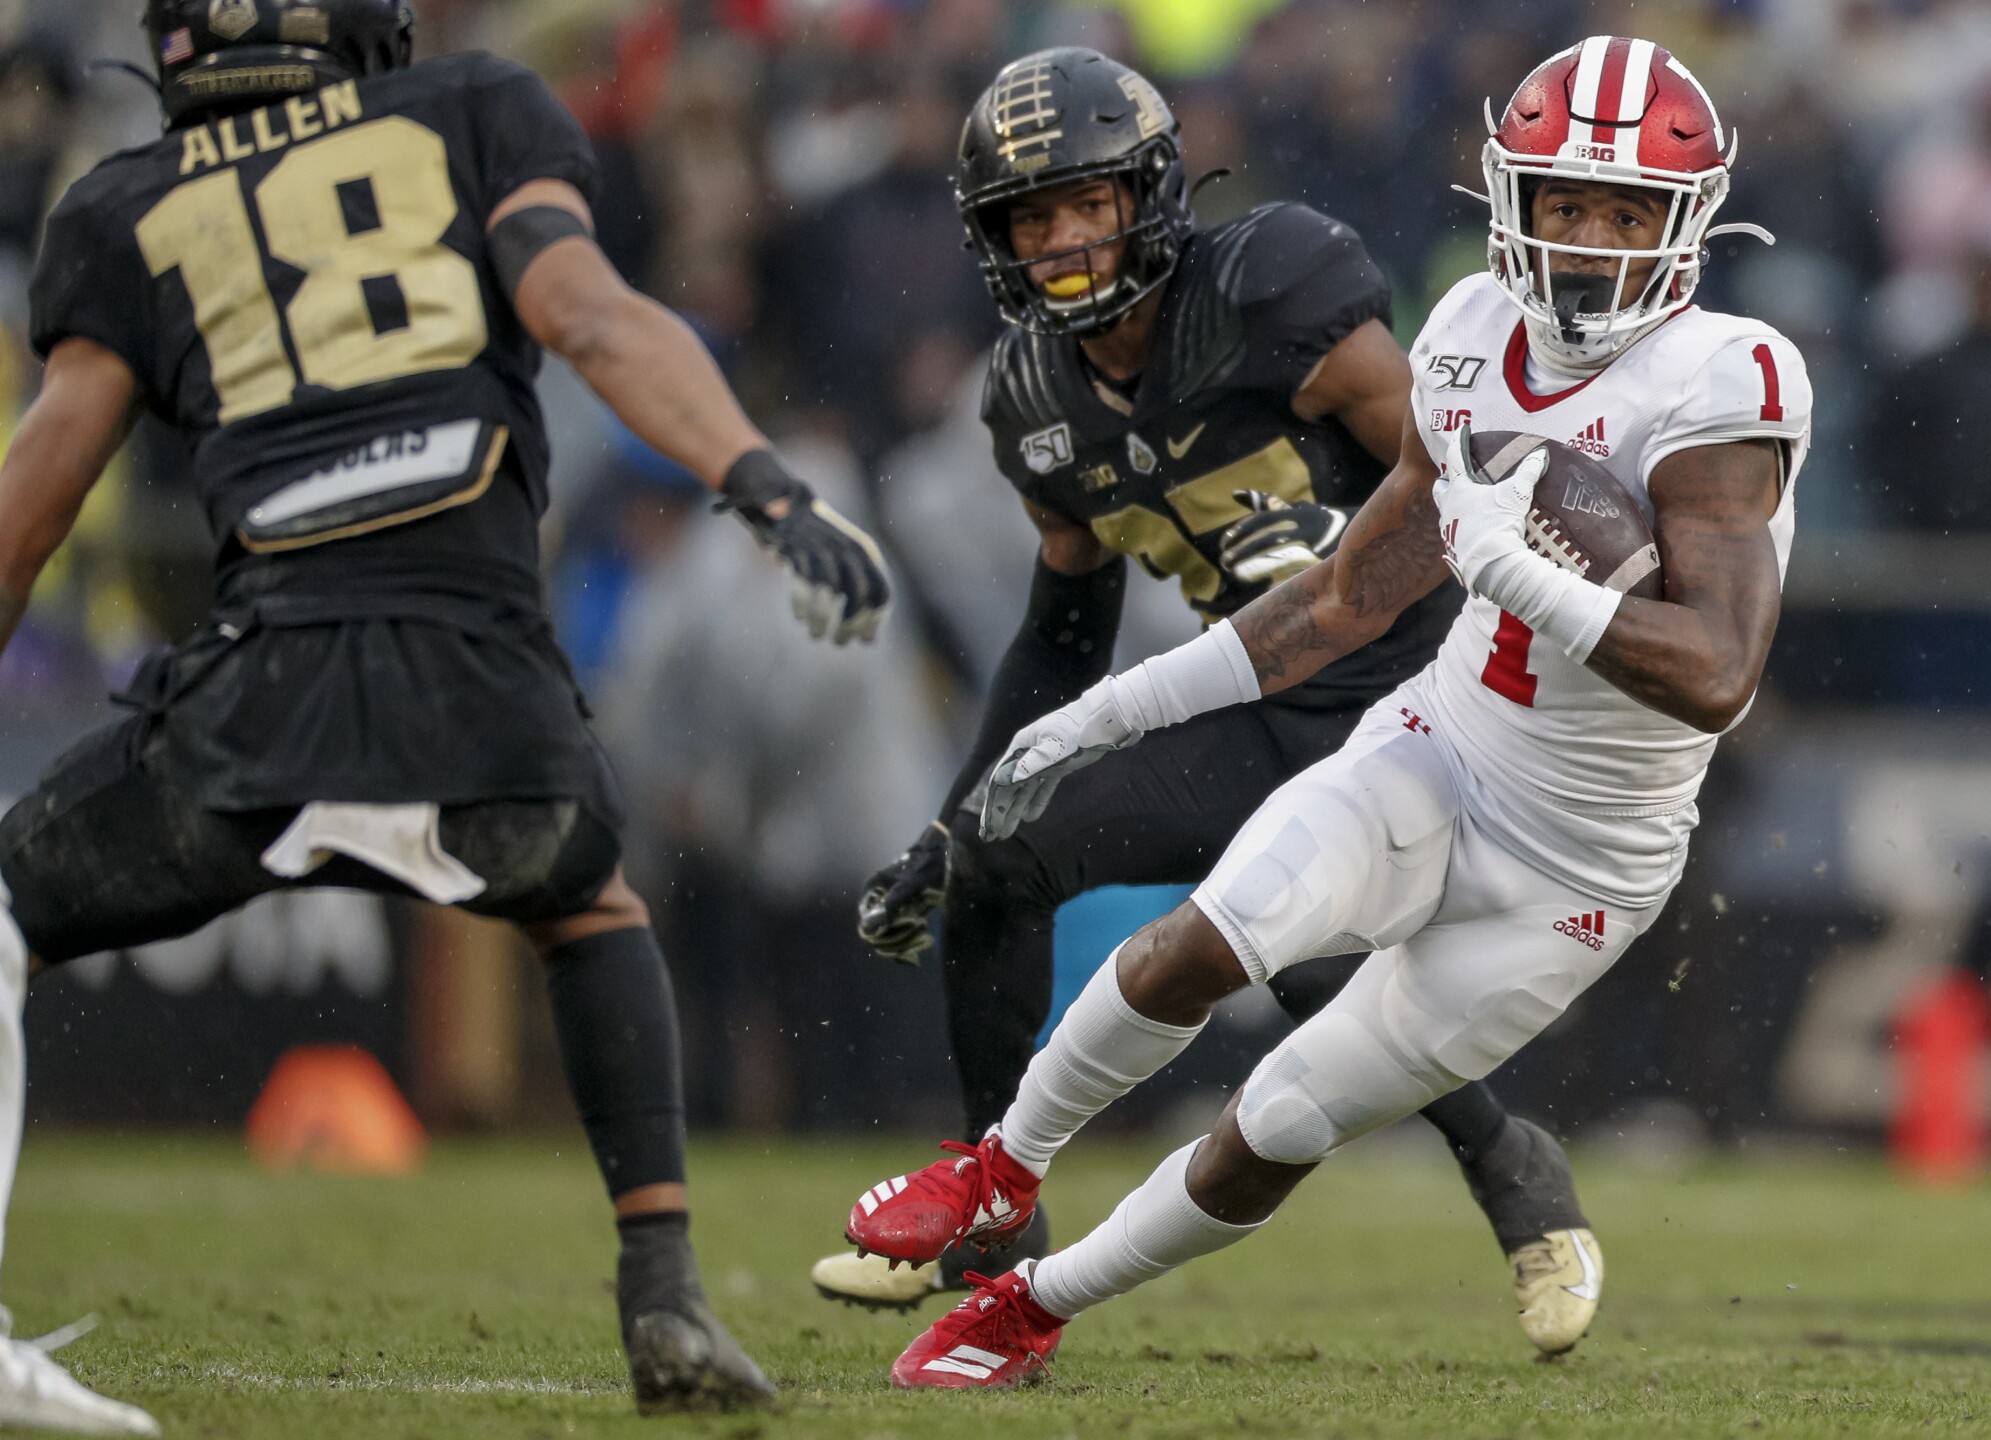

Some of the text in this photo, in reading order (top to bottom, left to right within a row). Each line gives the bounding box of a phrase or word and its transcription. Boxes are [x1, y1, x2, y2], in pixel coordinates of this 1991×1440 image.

[179, 78, 363, 176] ALLEN
[133, 114, 489, 429] 18
[1428, 355, 1487, 390] 150
[1751, 343, 1784, 422] 1
[1022, 425, 1073, 470] 150
[1567, 439, 1610, 457] adidas
[1553, 920, 1605, 951] adidas
